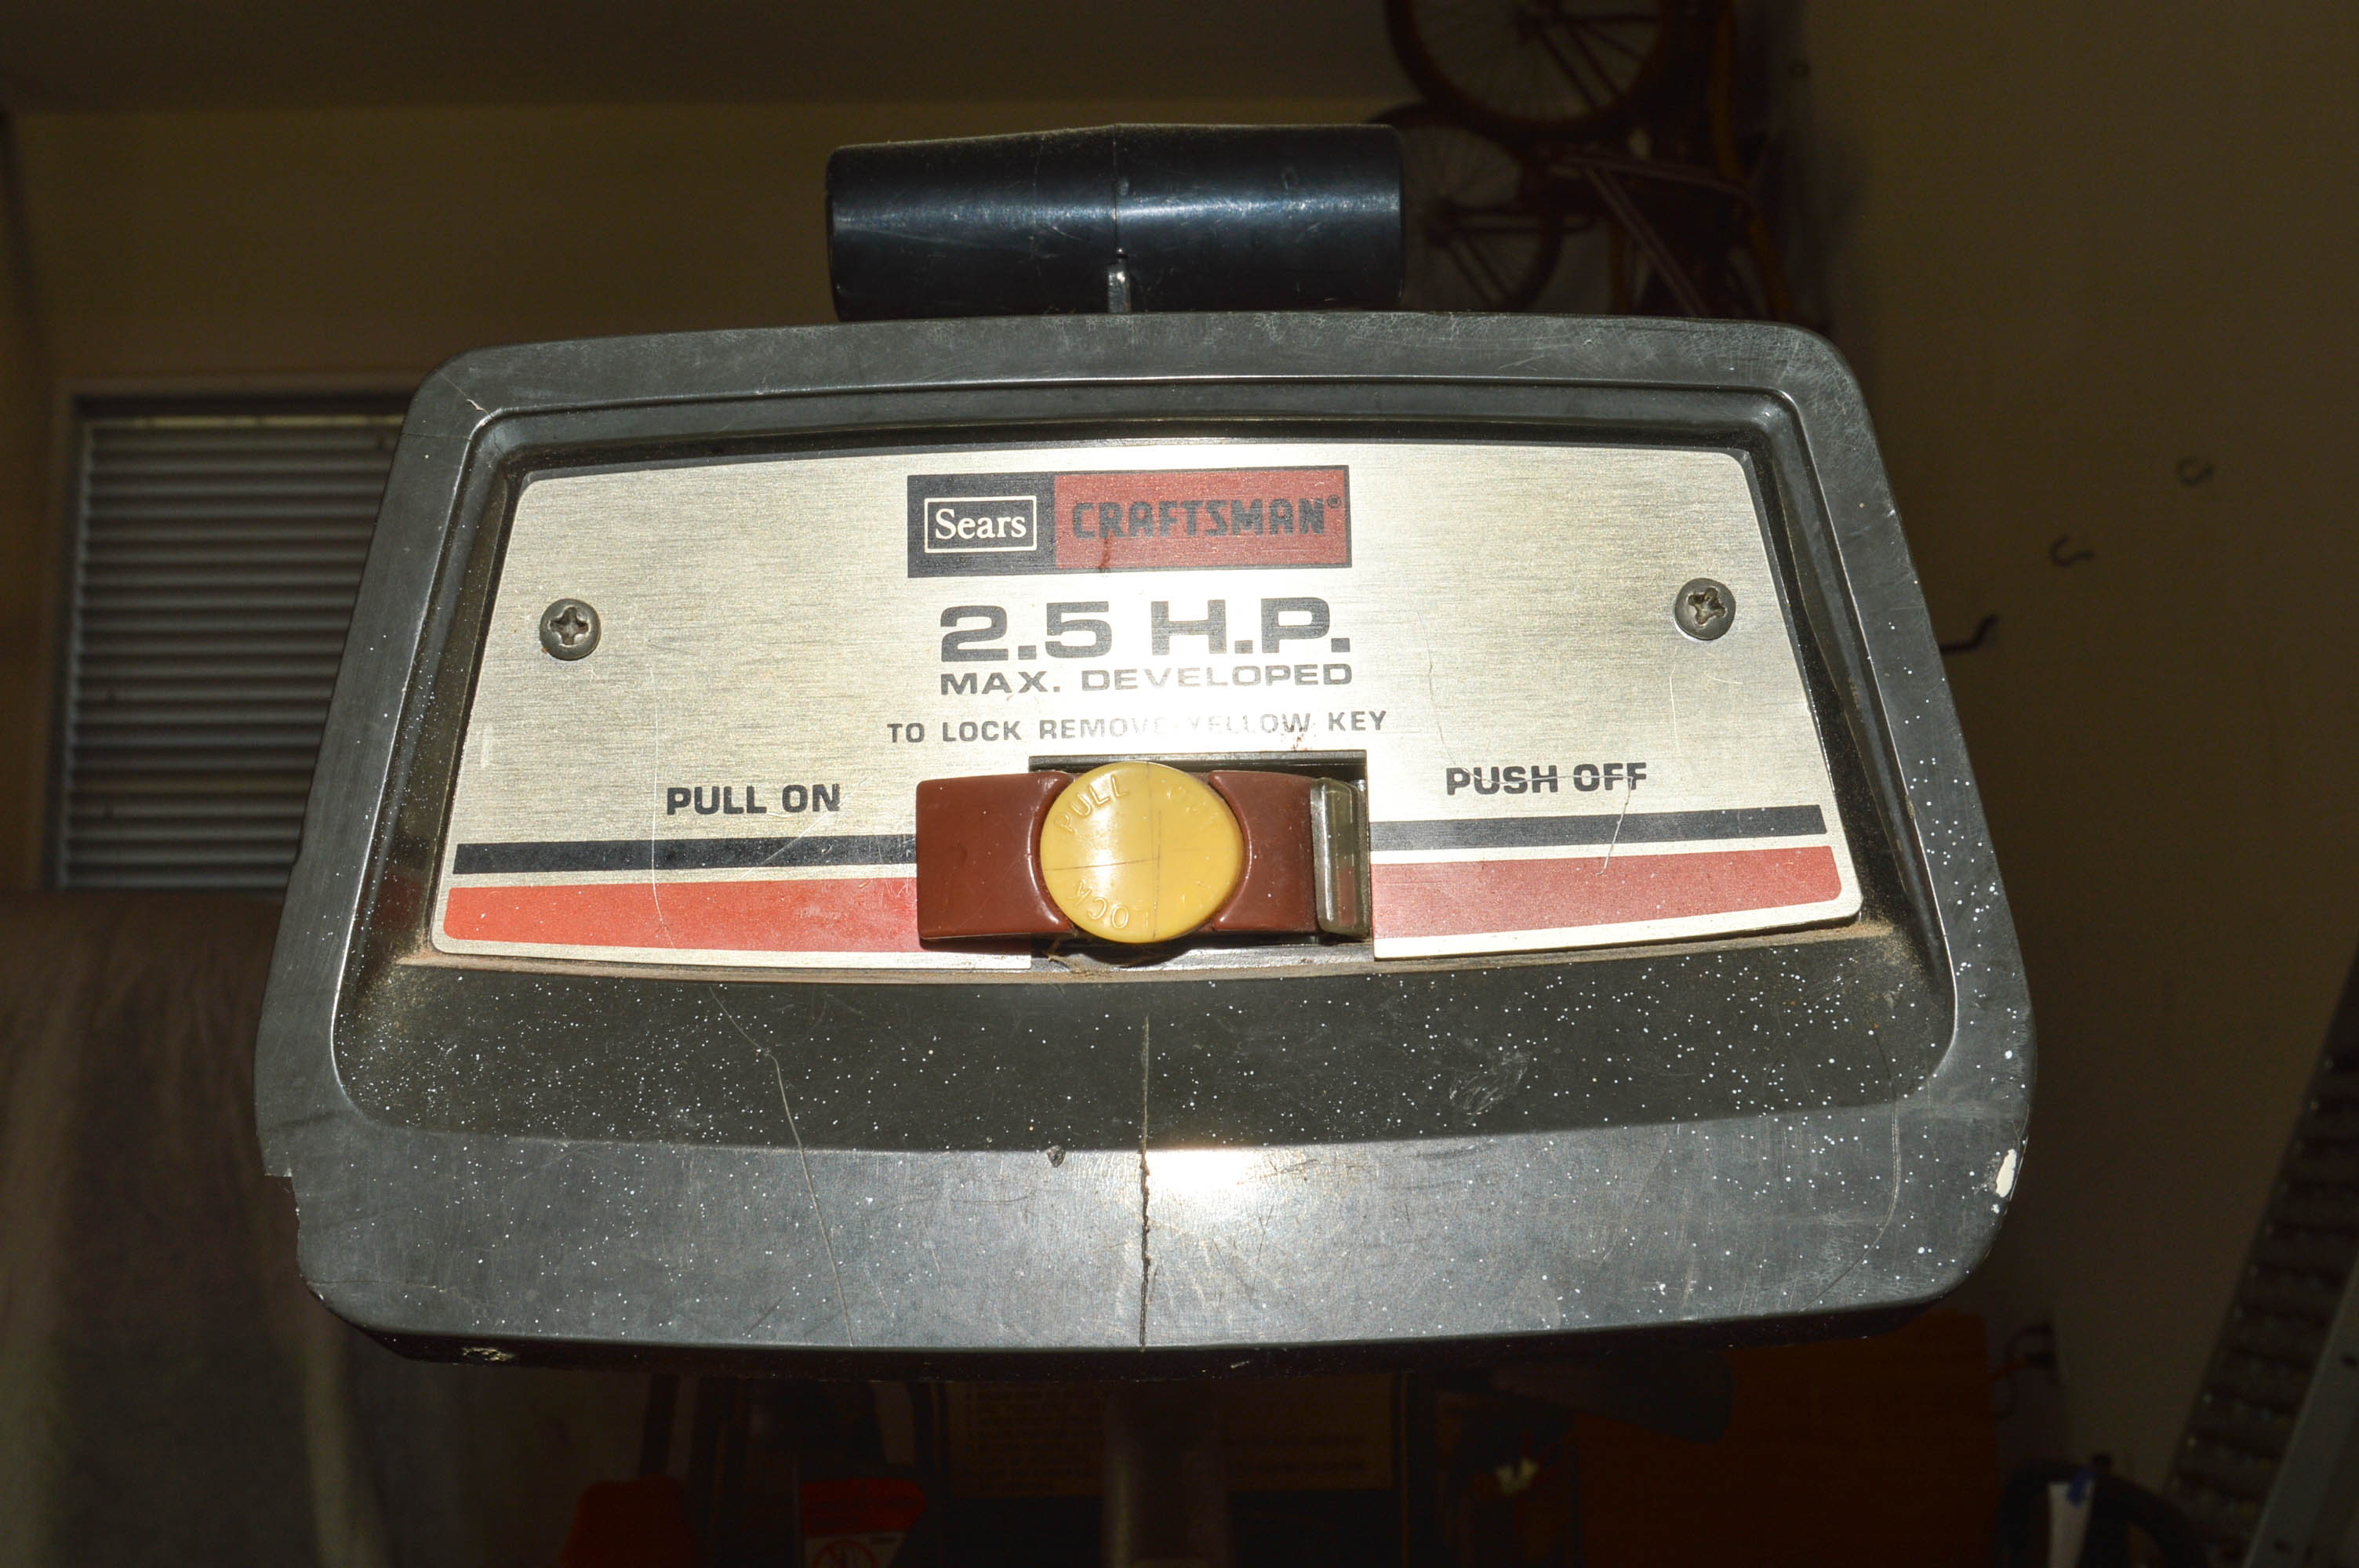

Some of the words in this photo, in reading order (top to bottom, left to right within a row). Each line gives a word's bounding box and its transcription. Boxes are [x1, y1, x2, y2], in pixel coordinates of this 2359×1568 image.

[935, 508, 1027, 540] Sears
[940, 601, 1113, 662] 2.5
[1150, 597, 1351, 655] H.P.
[940, 670, 1061, 695] MAX.
[1081, 663, 1353, 691] DEVELOPED
[887, 722, 925, 743] TO
[943, 720, 1022, 742] LOCK
[1039, 716, 1168, 740] REMOVE
[1186, 713, 1312, 735] YELLOW
[1329, 710, 1387, 731] KEY
[1446, 765, 1558, 795] PUSH
[1573, 762, 1647, 792] OFF
[667, 786, 767, 815] PULL
[782, 784, 840, 813] ON
[1054, 774, 1132, 835] PULL
